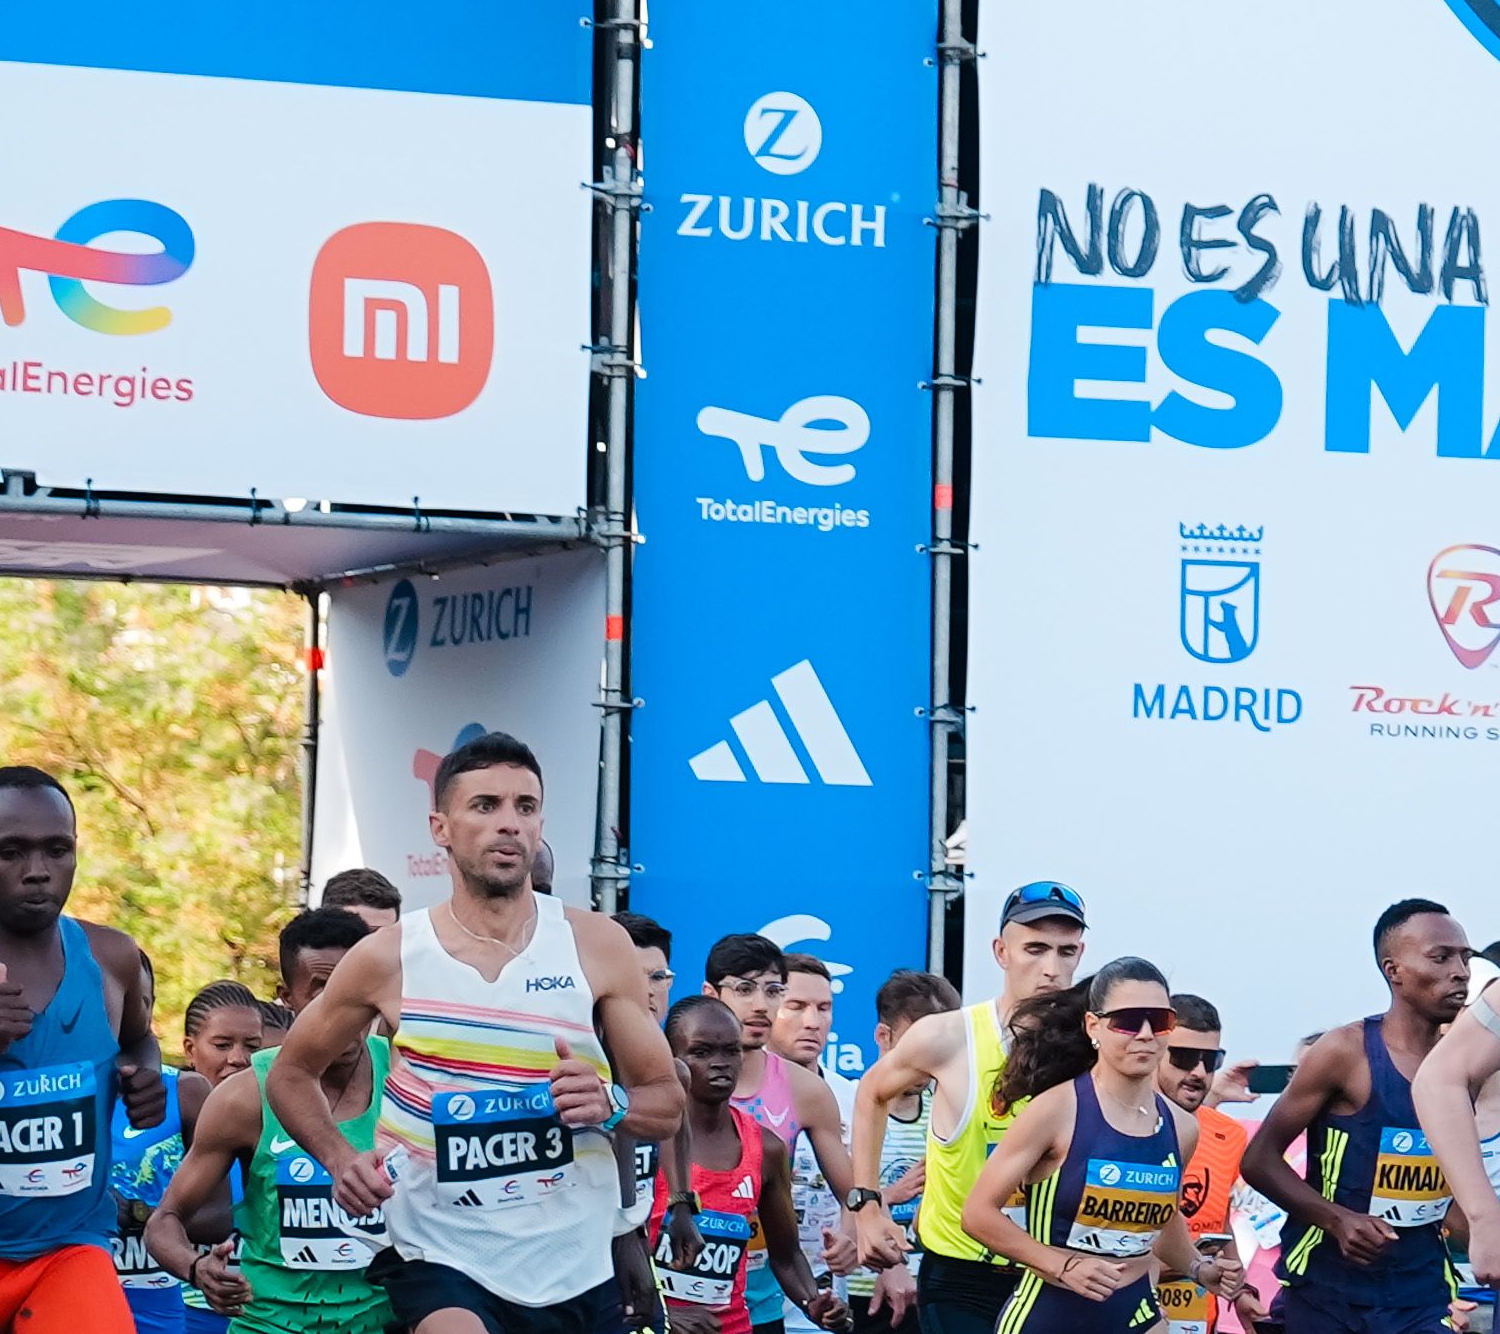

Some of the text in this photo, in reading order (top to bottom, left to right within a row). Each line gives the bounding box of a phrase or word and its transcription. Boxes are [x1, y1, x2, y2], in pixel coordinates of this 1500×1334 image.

[676, 192, 887, 248] ZURICH
[1034, 182, 1160, 289] NO
[1179, 191, 1282, 304] ES
[1300, 200, 1490, 308] UNA
[1027, 281, 1285, 451] ES
[696, 496, 870, 532] TotalEnergies
[429, 585, 535, 648] ZURICH
[1133, 682, 1303, 734] MADRID
[1369, 723, 1481, 742] RUNNING
[525, 975, 576, 993] HOKA
[13, 1072, 82, 1098] ZURICH
[483, 1091, 551, 1115] ZURICH
[71, 1111, 84, 1147] 1
[447, 1126, 564, 1171] PACER 3
[1125, 1170, 1174, 1186] ZURICH
[699, 1215, 745, 1233] ZURICH
[1082, 1195, 1175, 1225] BARREIRO
